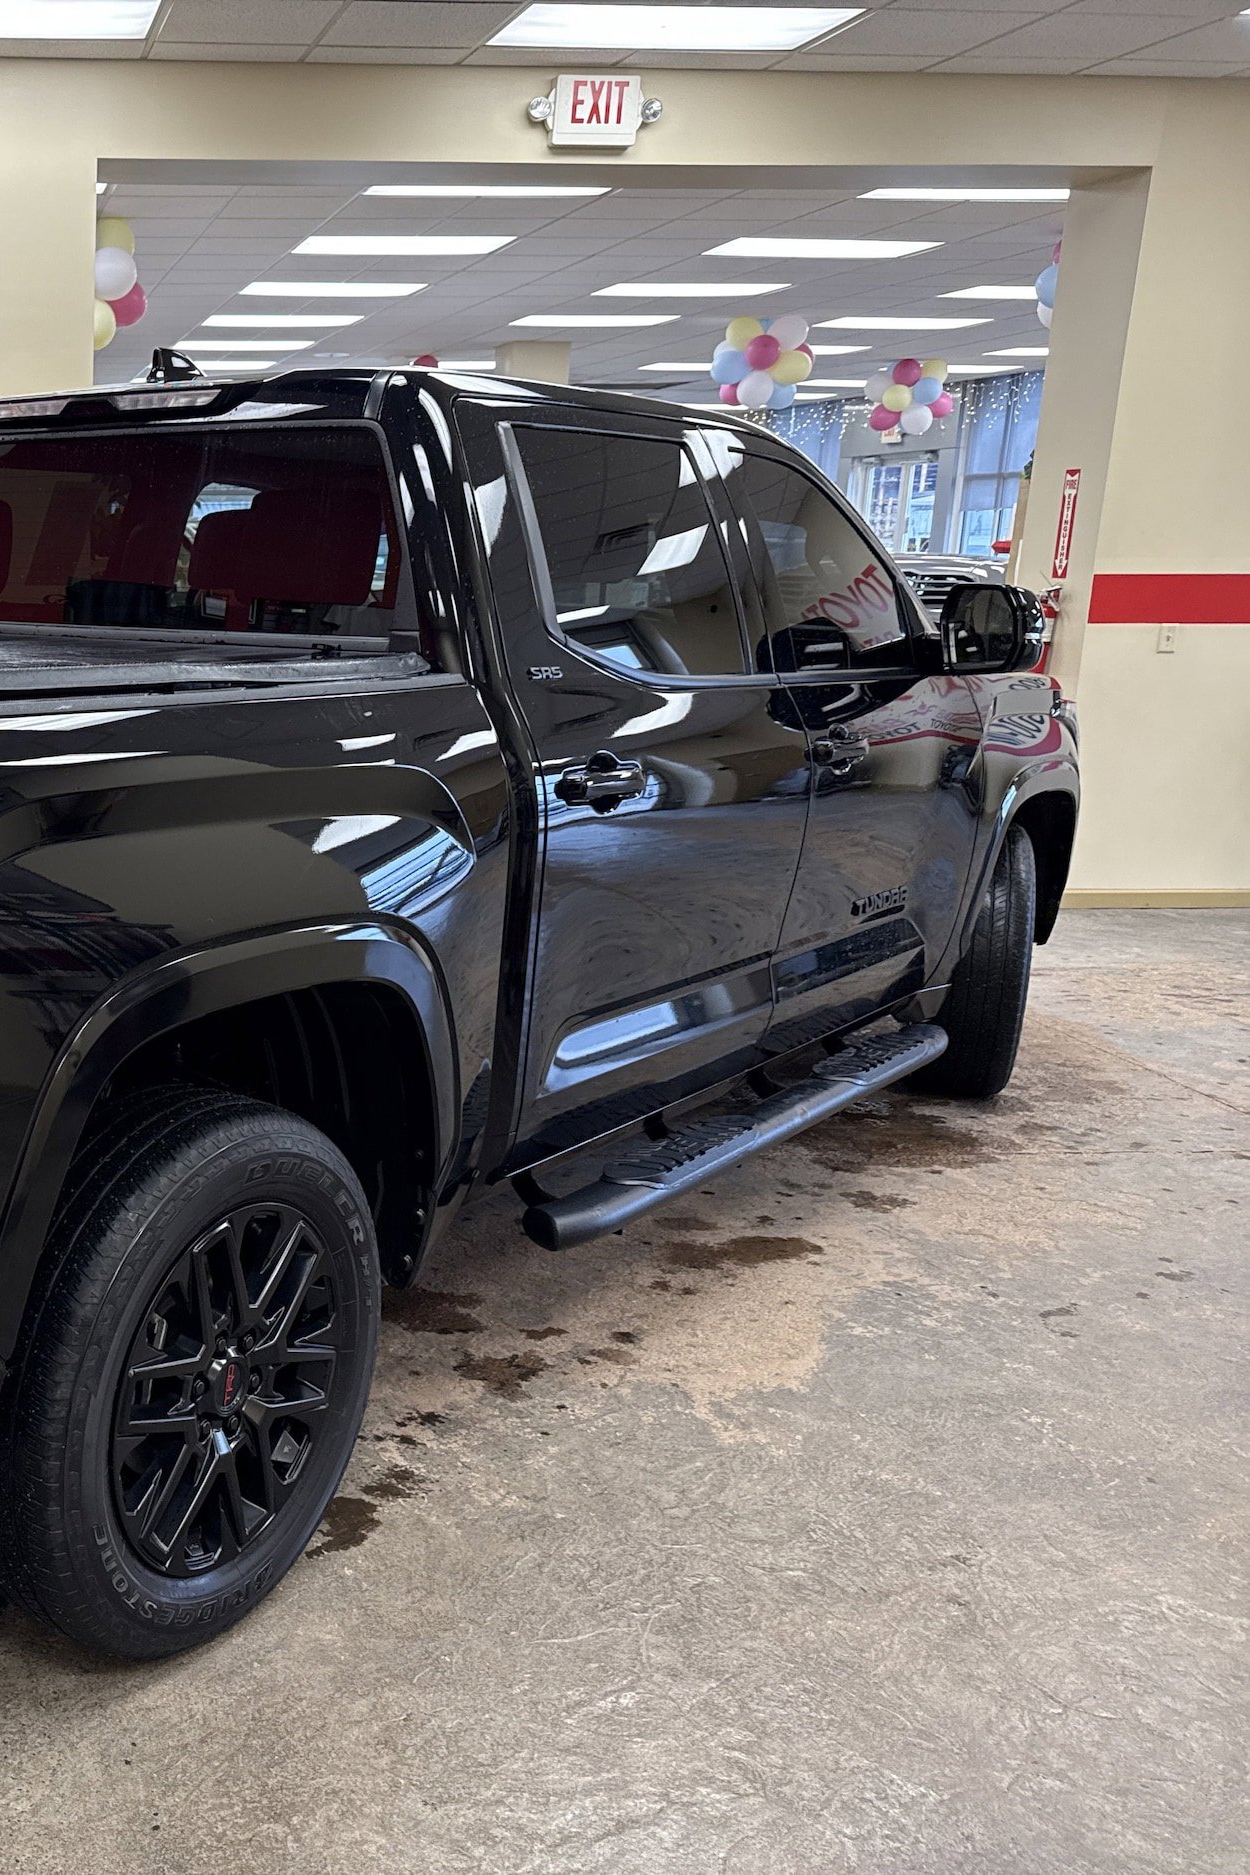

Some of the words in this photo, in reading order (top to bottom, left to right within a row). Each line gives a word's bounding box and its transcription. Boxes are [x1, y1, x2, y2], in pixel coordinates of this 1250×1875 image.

[571, 80, 630, 124] EXIT
[1065, 479, 1078, 489] FIRE
[1057, 493, 1072, 570] EXTINGUISHER
[529, 666, 564, 680] SR5
[853, 885, 909, 916] TUNDRA
[244, 1156, 365, 1246] DUELER
[92, 1521, 274, 1627] BRIDGESTONE
